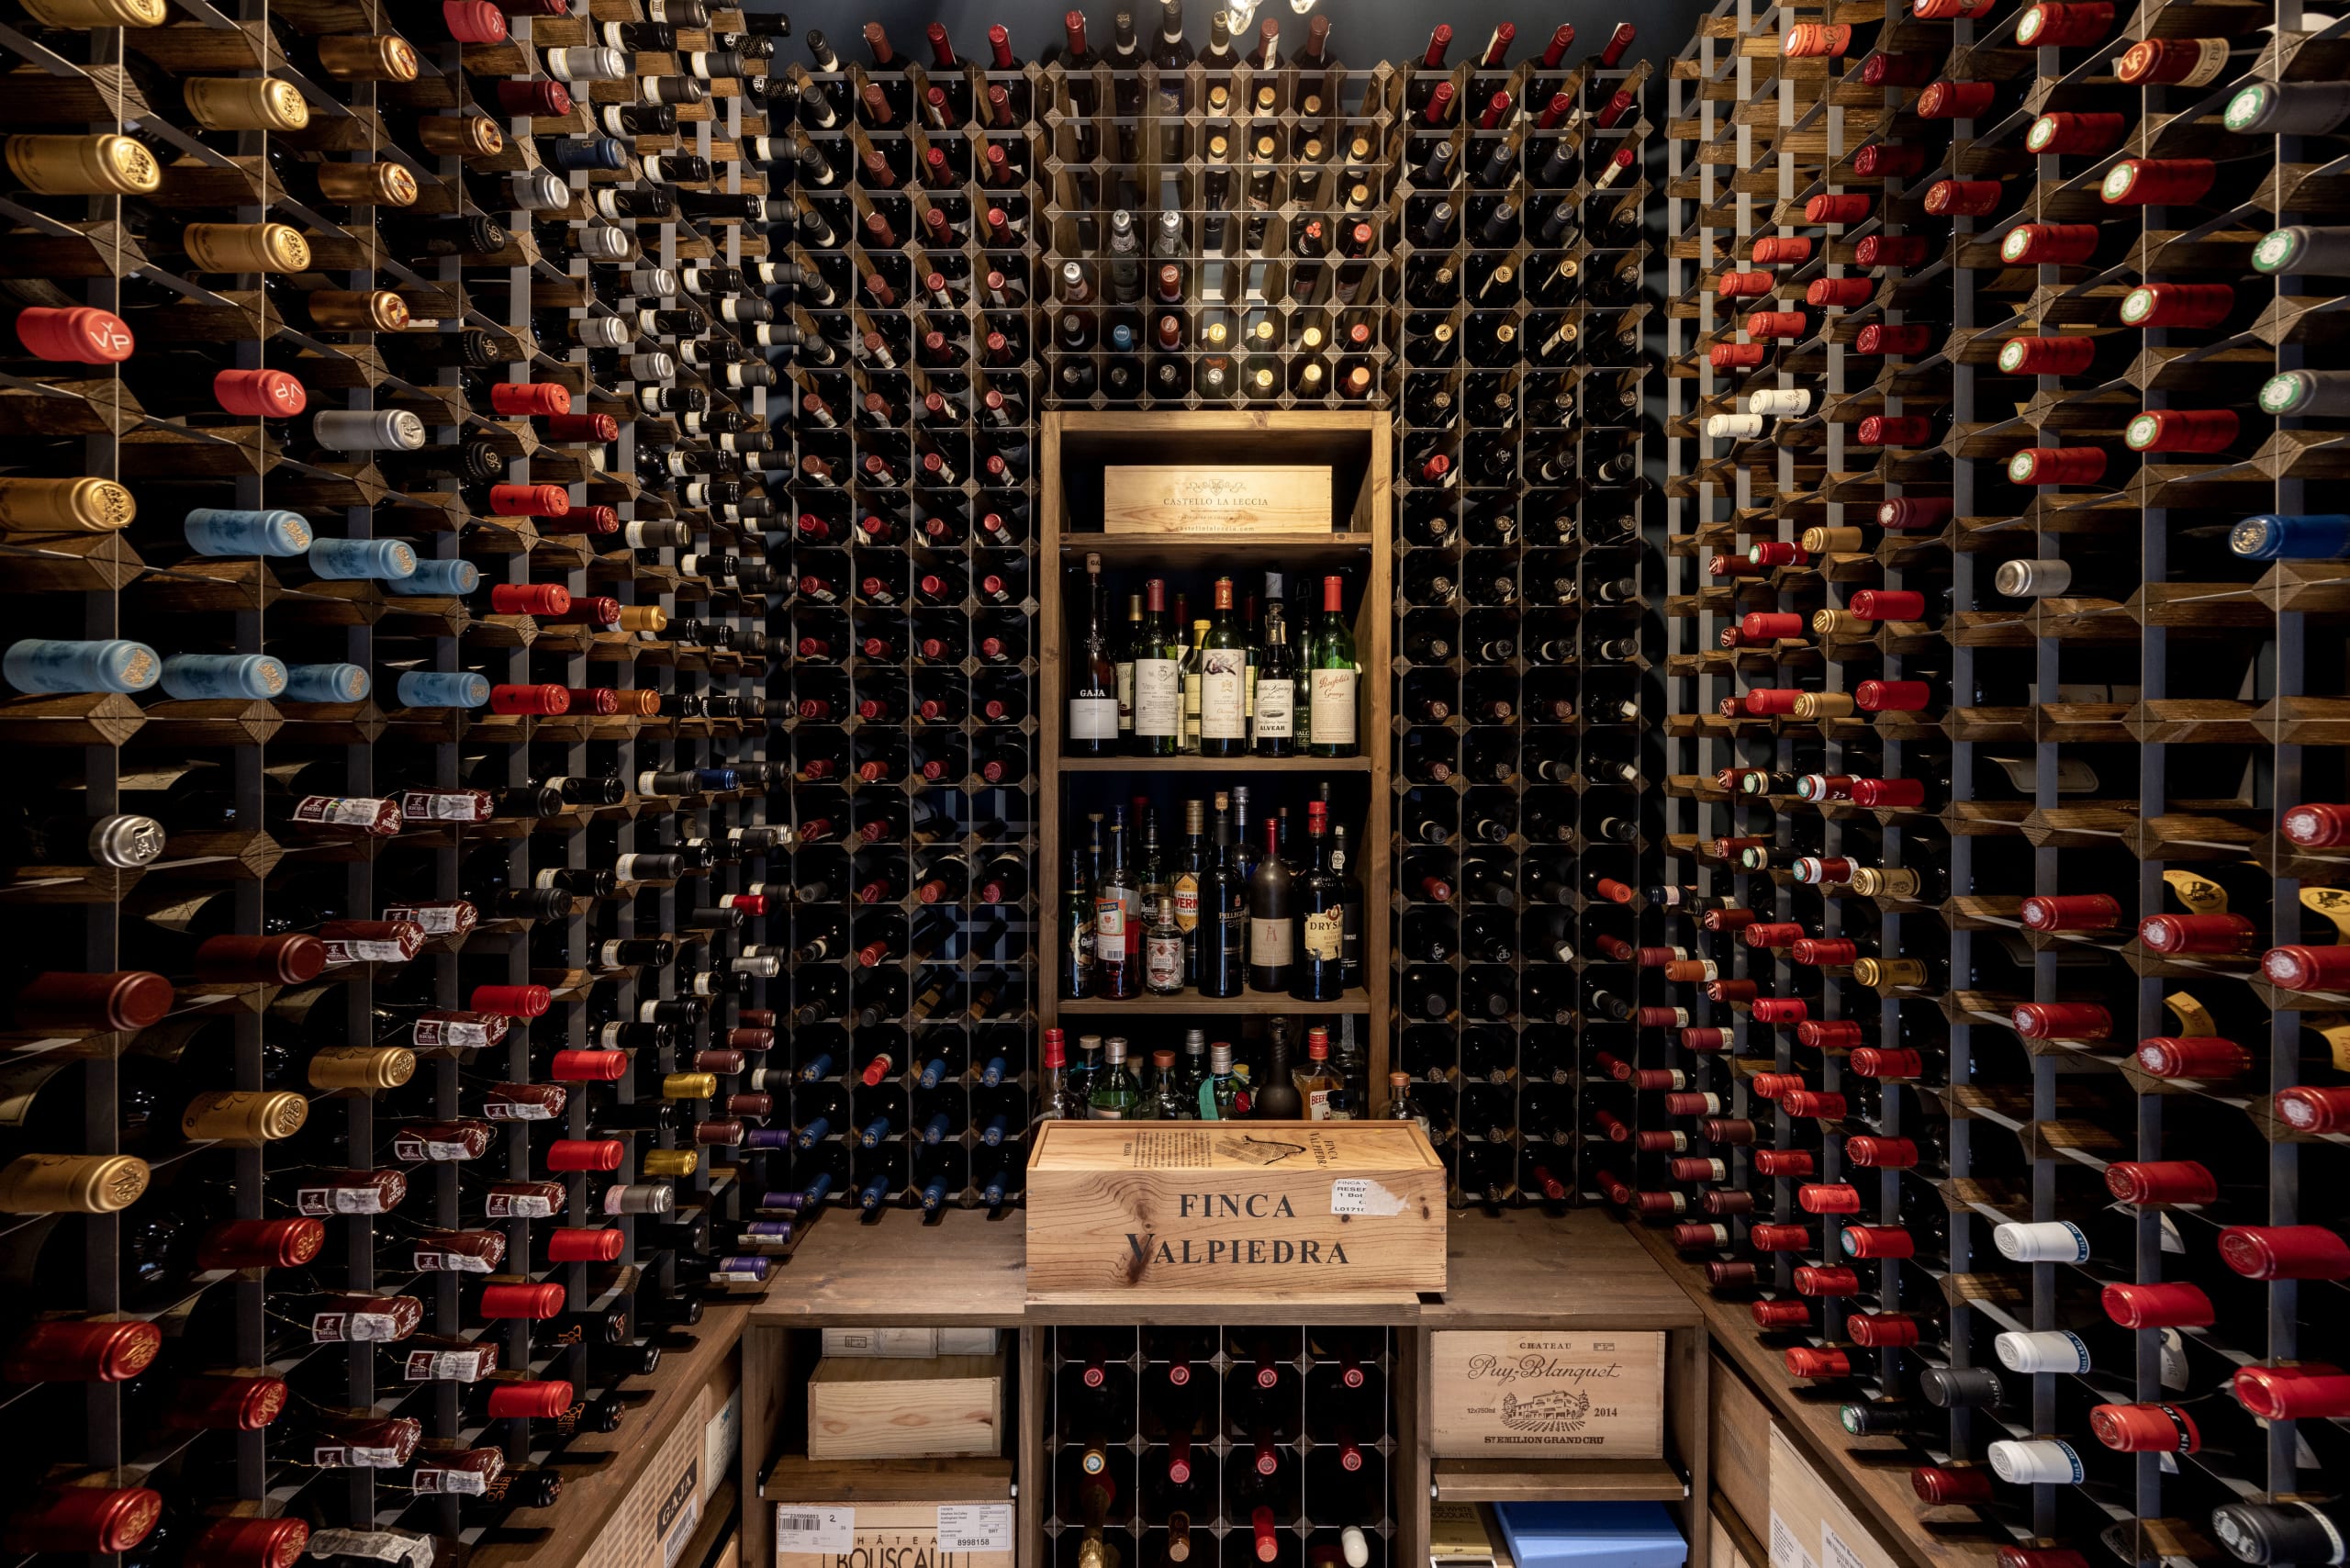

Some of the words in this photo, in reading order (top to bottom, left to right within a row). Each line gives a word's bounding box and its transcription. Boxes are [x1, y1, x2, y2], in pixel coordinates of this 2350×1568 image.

[90, 331, 130, 351] VP
[1163, 498, 1213, 506] CASTELLO
[1217, 498, 1228, 506] LA
[1233, 498, 1269, 506] LECCIA
[1080, 689, 1106, 698] GAJA
[1311, 1094, 1327, 1105] BEEF
[1180, 1193, 1296, 1219] FINCA
[1125, 1233, 1351, 1266] VALPIEDRA
[1468, 1353, 1623, 1386] Puy-Blanquet
[1594, 1407, 1618, 1417] 2014
[1497, 1436, 1543, 1445] EMILION
[1544, 1436, 1583, 1445] GRAND
[1583, 1436, 1605, 1445] CRU
[662, 1474, 693, 1526] GAJA
[829, 1514, 837, 1523] 2
